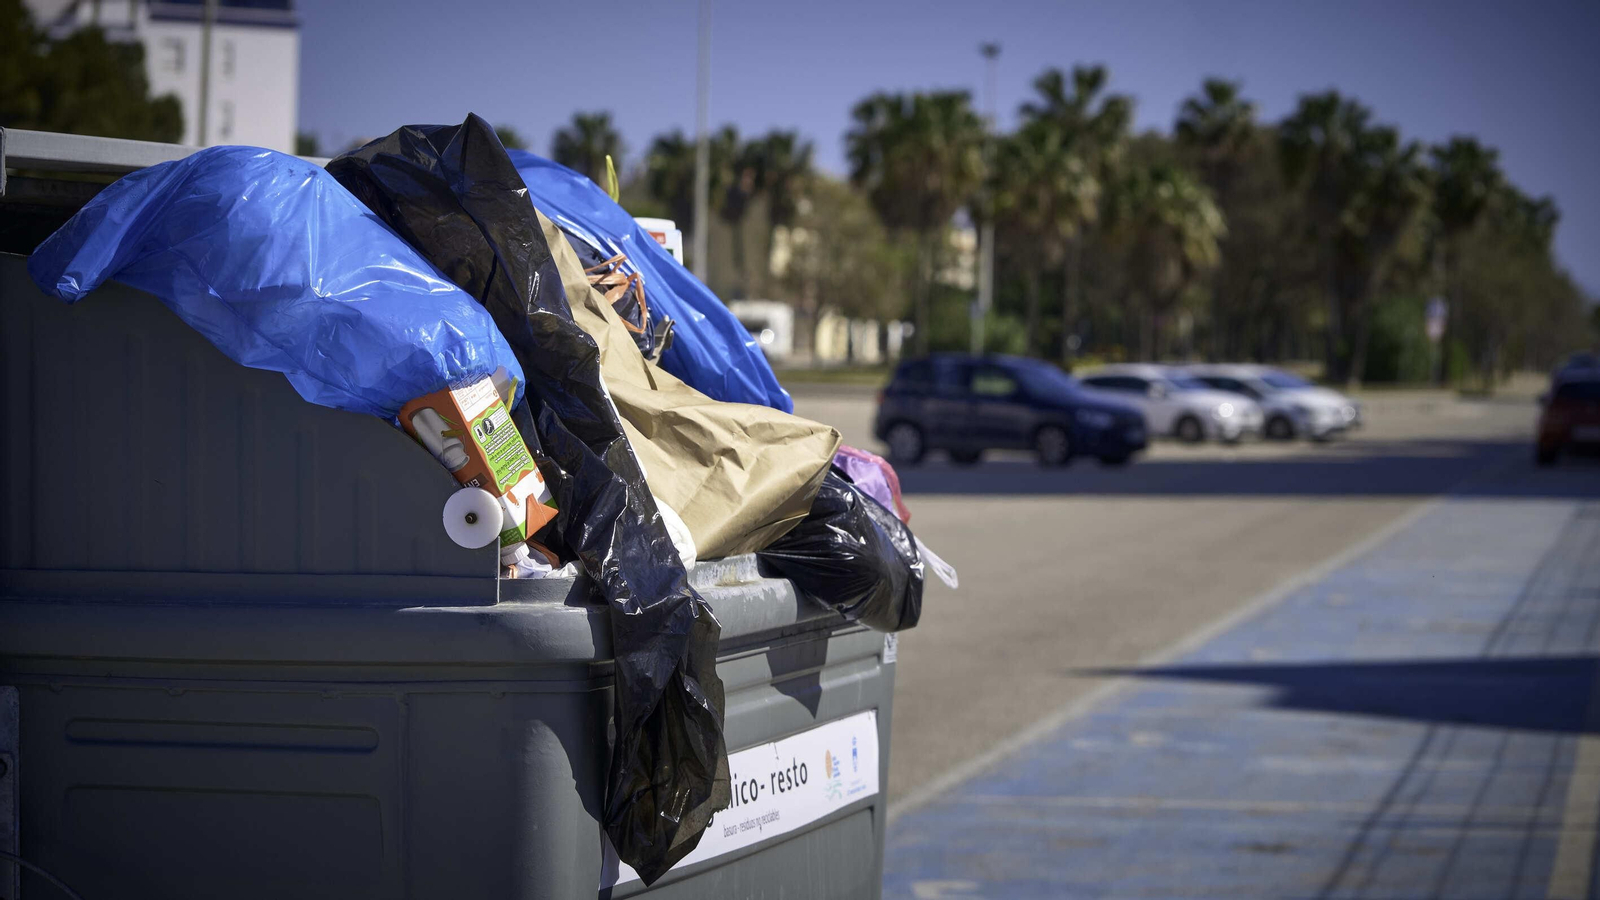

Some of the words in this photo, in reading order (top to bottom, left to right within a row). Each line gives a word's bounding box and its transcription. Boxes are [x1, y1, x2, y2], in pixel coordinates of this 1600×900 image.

[770, 757, 808, 795] resto
[723, 823, 738, 838] basura
[740, 816, 756, 832] residuos
